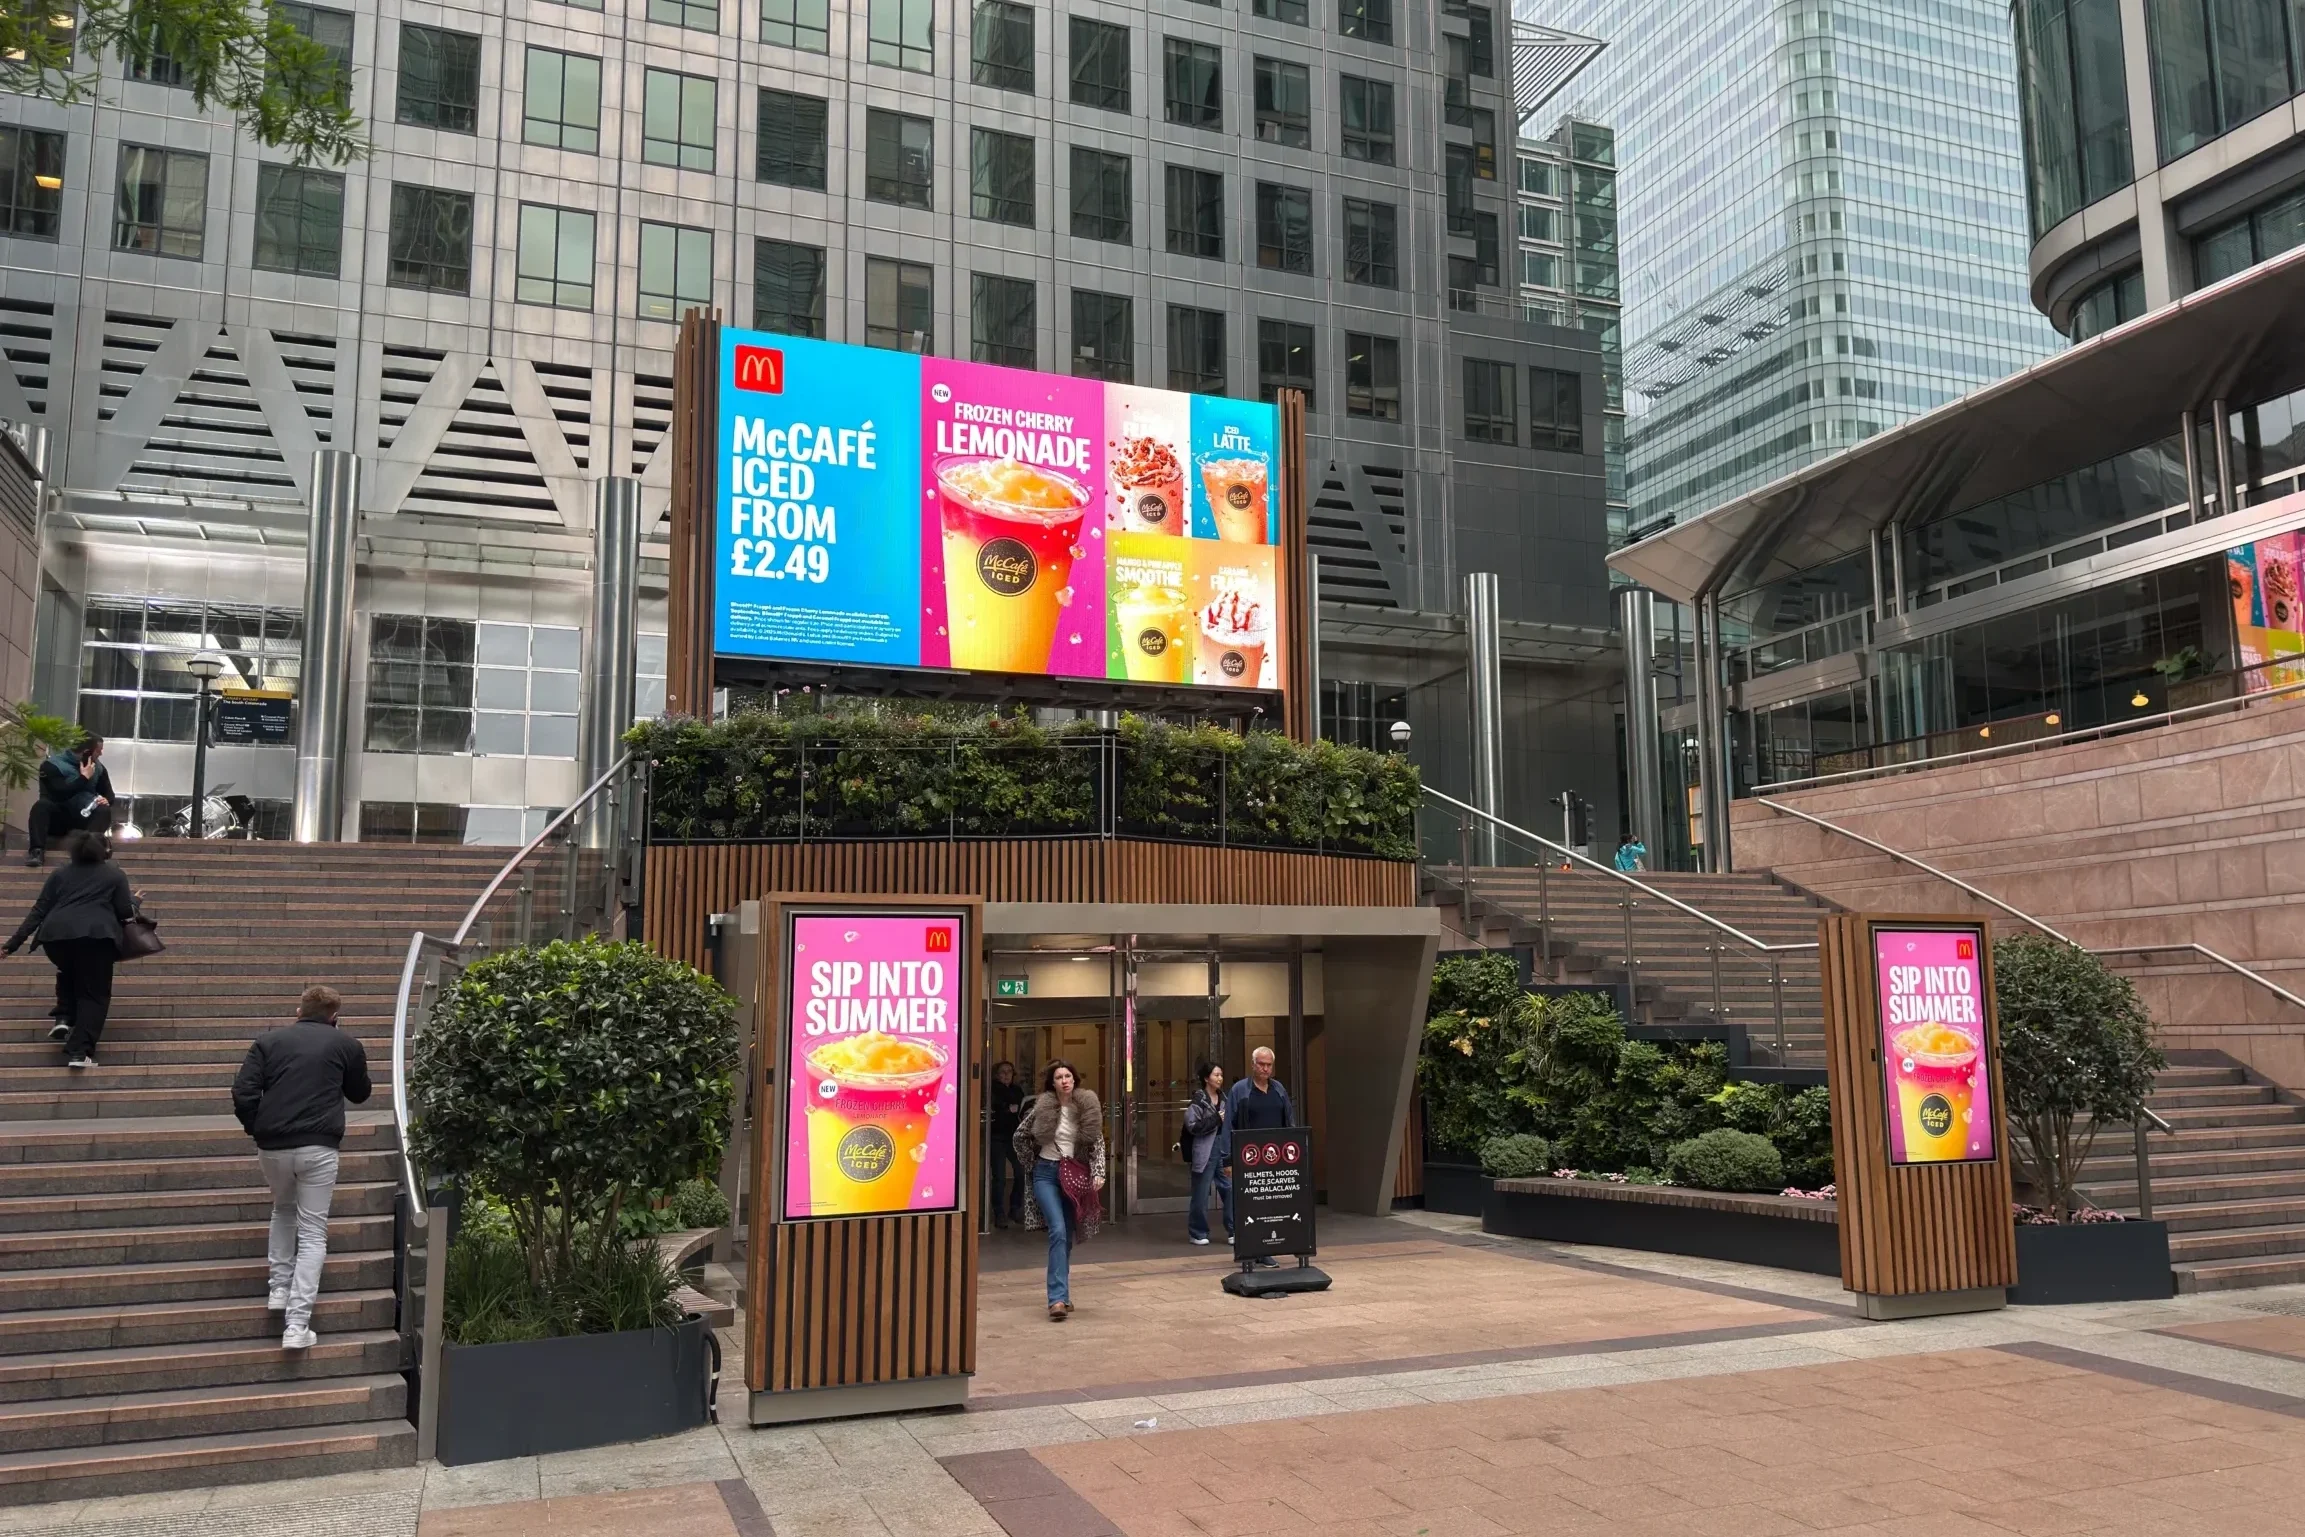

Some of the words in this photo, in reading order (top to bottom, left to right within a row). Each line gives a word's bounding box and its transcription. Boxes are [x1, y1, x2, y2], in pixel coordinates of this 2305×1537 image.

[934, 388, 949, 398] NEW
[954, 401, 1013, 426] FROZEN
[1015, 409, 1074, 434] CHERRY
[1224, 426, 1239, 435] ICED
[732, 415, 876, 470] McCAFÉ
[936, 419, 1091, 472] LEMONADE
[1213, 432, 1251, 452] LATTE
[732, 455, 815, 501] ICED
[731, 496, 837, 544] FROM
[731, 537, 830, 584] £2.49
[983, 555, 1029, 575] McCafé
[992, 572, 1020, 584] ICED
[1116, 566, 1183, 587] SMOOTHIE
[811, 960, 863, 998] SIP
[869, 960, 944, 997] INTO
[1889, 965, 1921, 994] SIP
[1925, 966, 1971, 994] INTO
[805, 998, 947, 1036] SUMMER
[1888, 995, 1976, 1024] SUMMER
[820, 1085, 836, 1094] NEW
[835, 1098, 870, 1110] FROZEN
[872, 1100, 907, 1111] CHERRY
[844, 1143, 887, 1160] McCafé
[850, 1160, 878, 1170] ICED
[1244, 1171, 1275, 1179] HELMETS,
[1266, 1177, 1295, 1185] SCARVES
